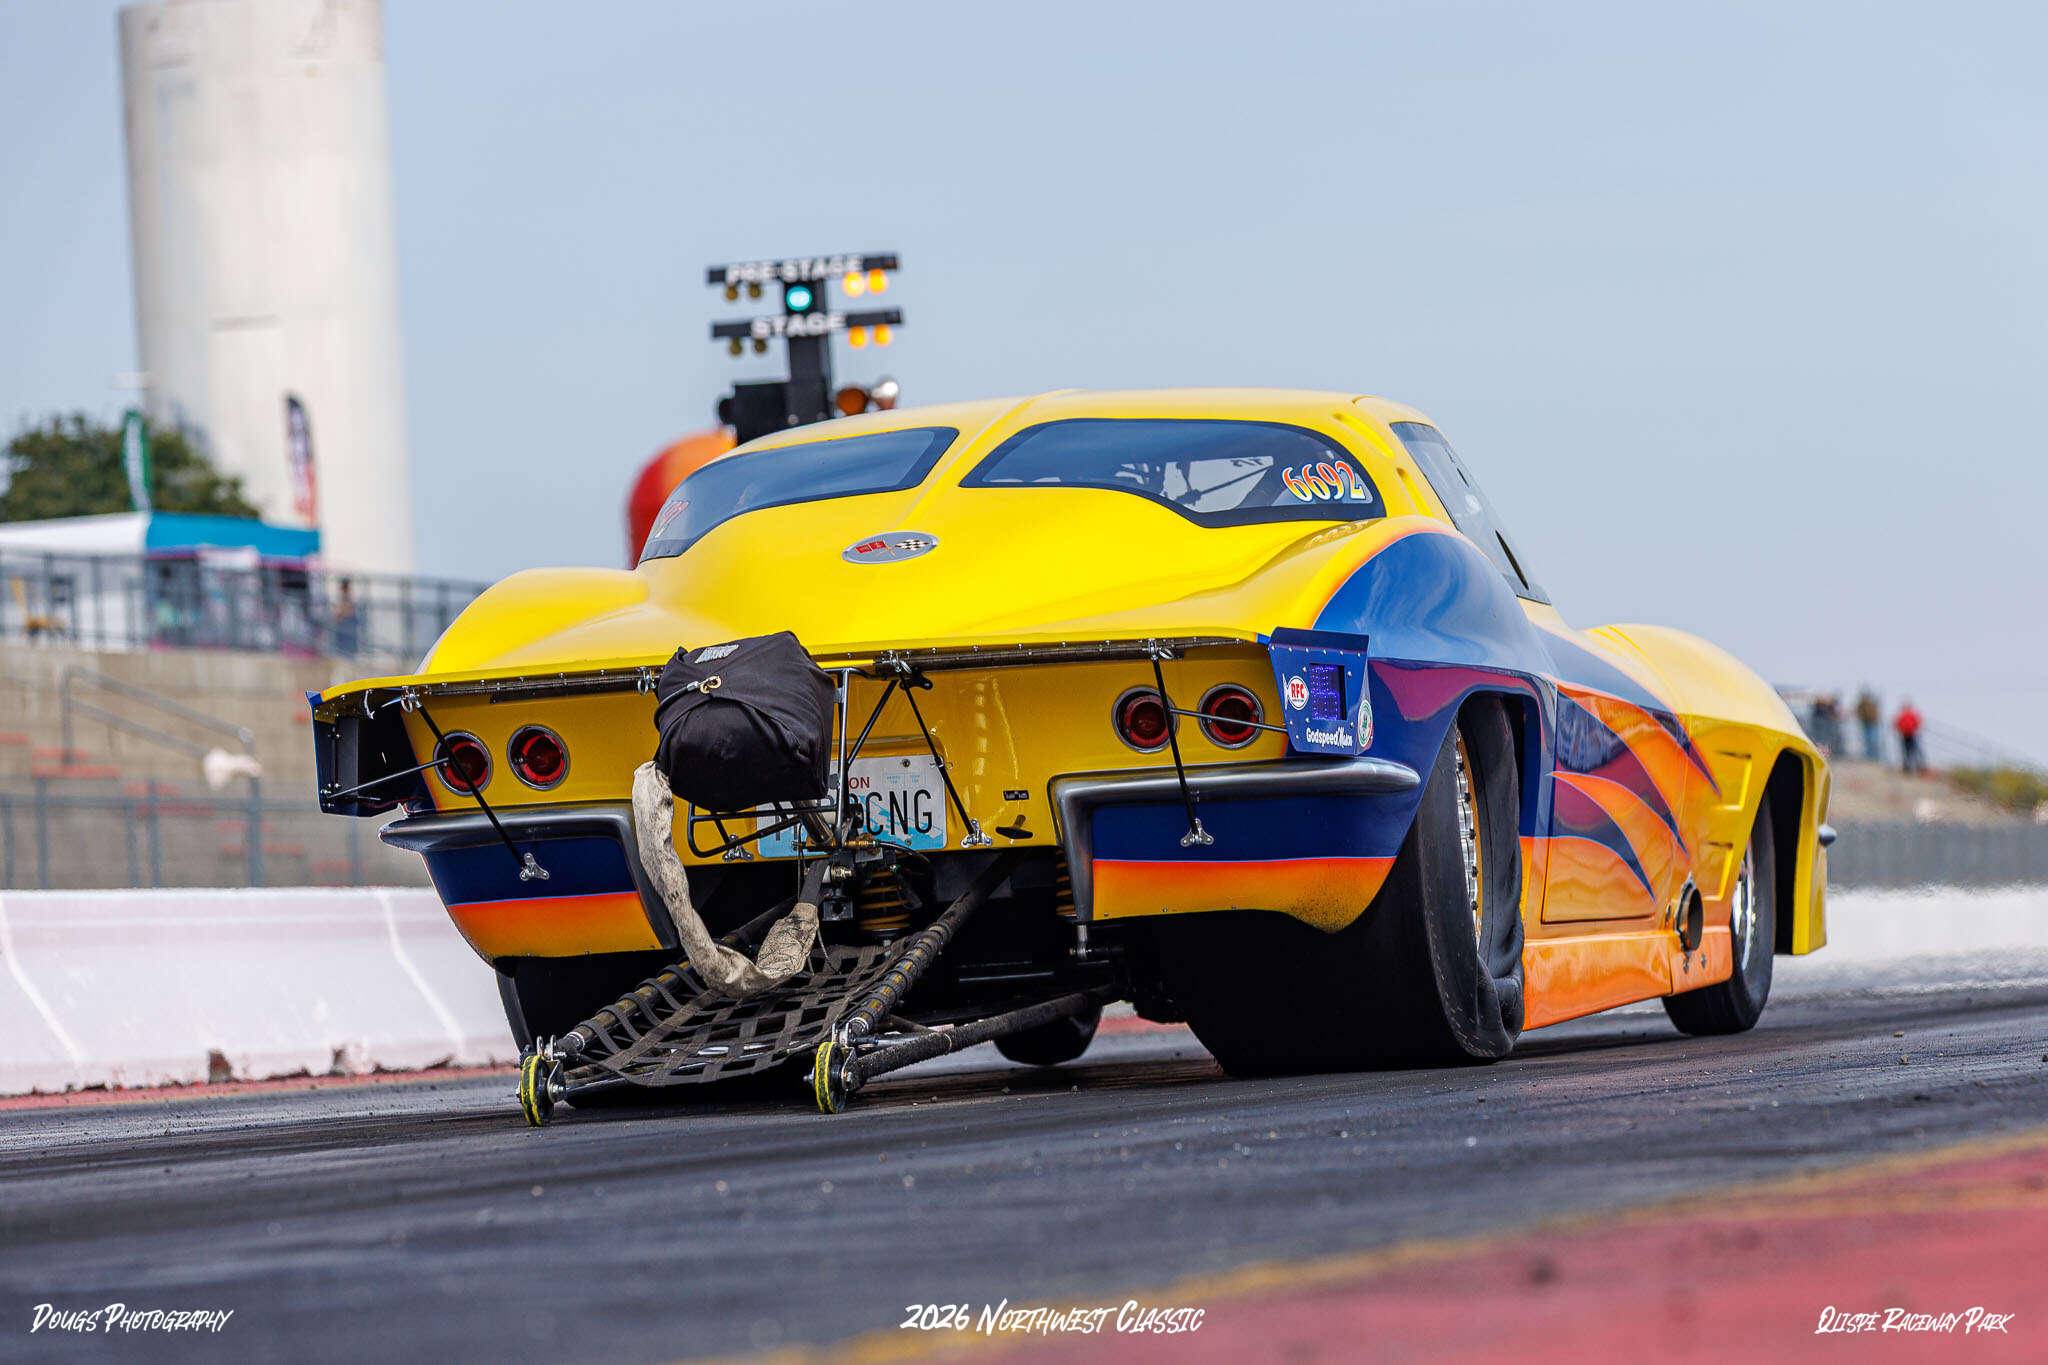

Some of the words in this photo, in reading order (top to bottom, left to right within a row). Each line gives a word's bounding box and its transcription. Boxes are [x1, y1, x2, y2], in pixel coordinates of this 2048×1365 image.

[750, 311, 848, 338] STAGE
[1281, 460, 1366, 502] 6692
[1291, 683, 1304, 698] RFC
